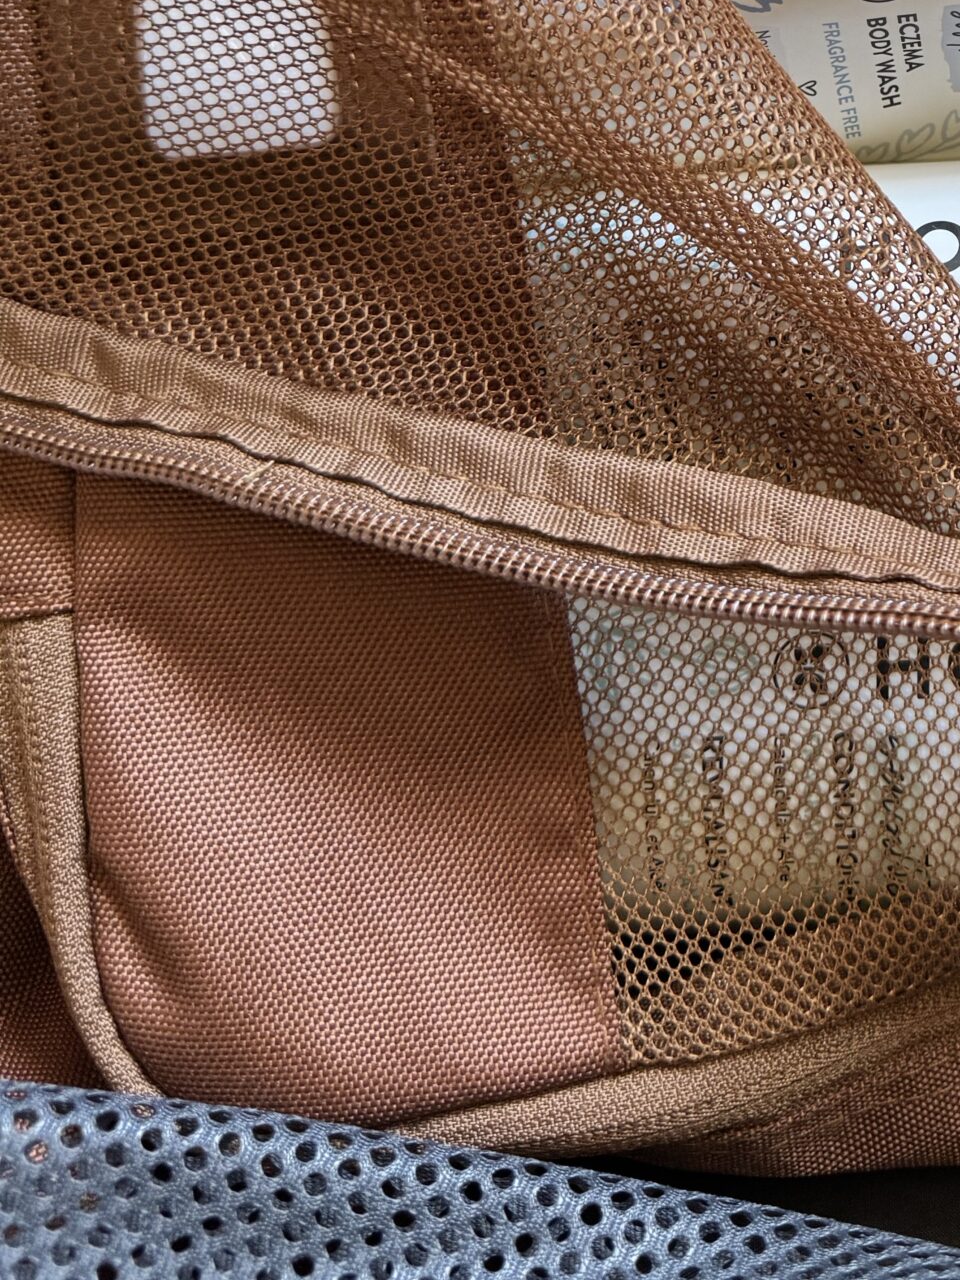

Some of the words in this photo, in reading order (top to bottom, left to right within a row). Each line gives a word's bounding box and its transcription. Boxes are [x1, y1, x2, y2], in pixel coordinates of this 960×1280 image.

[866, 17, 894, 56] BODY
[897, 13, 925, 72] ECZEMA
[822, 22, 855, 105] FRAGRANCE
[840, 107, 861, 139] FREE
[875, 59, 902, 108] WASH
